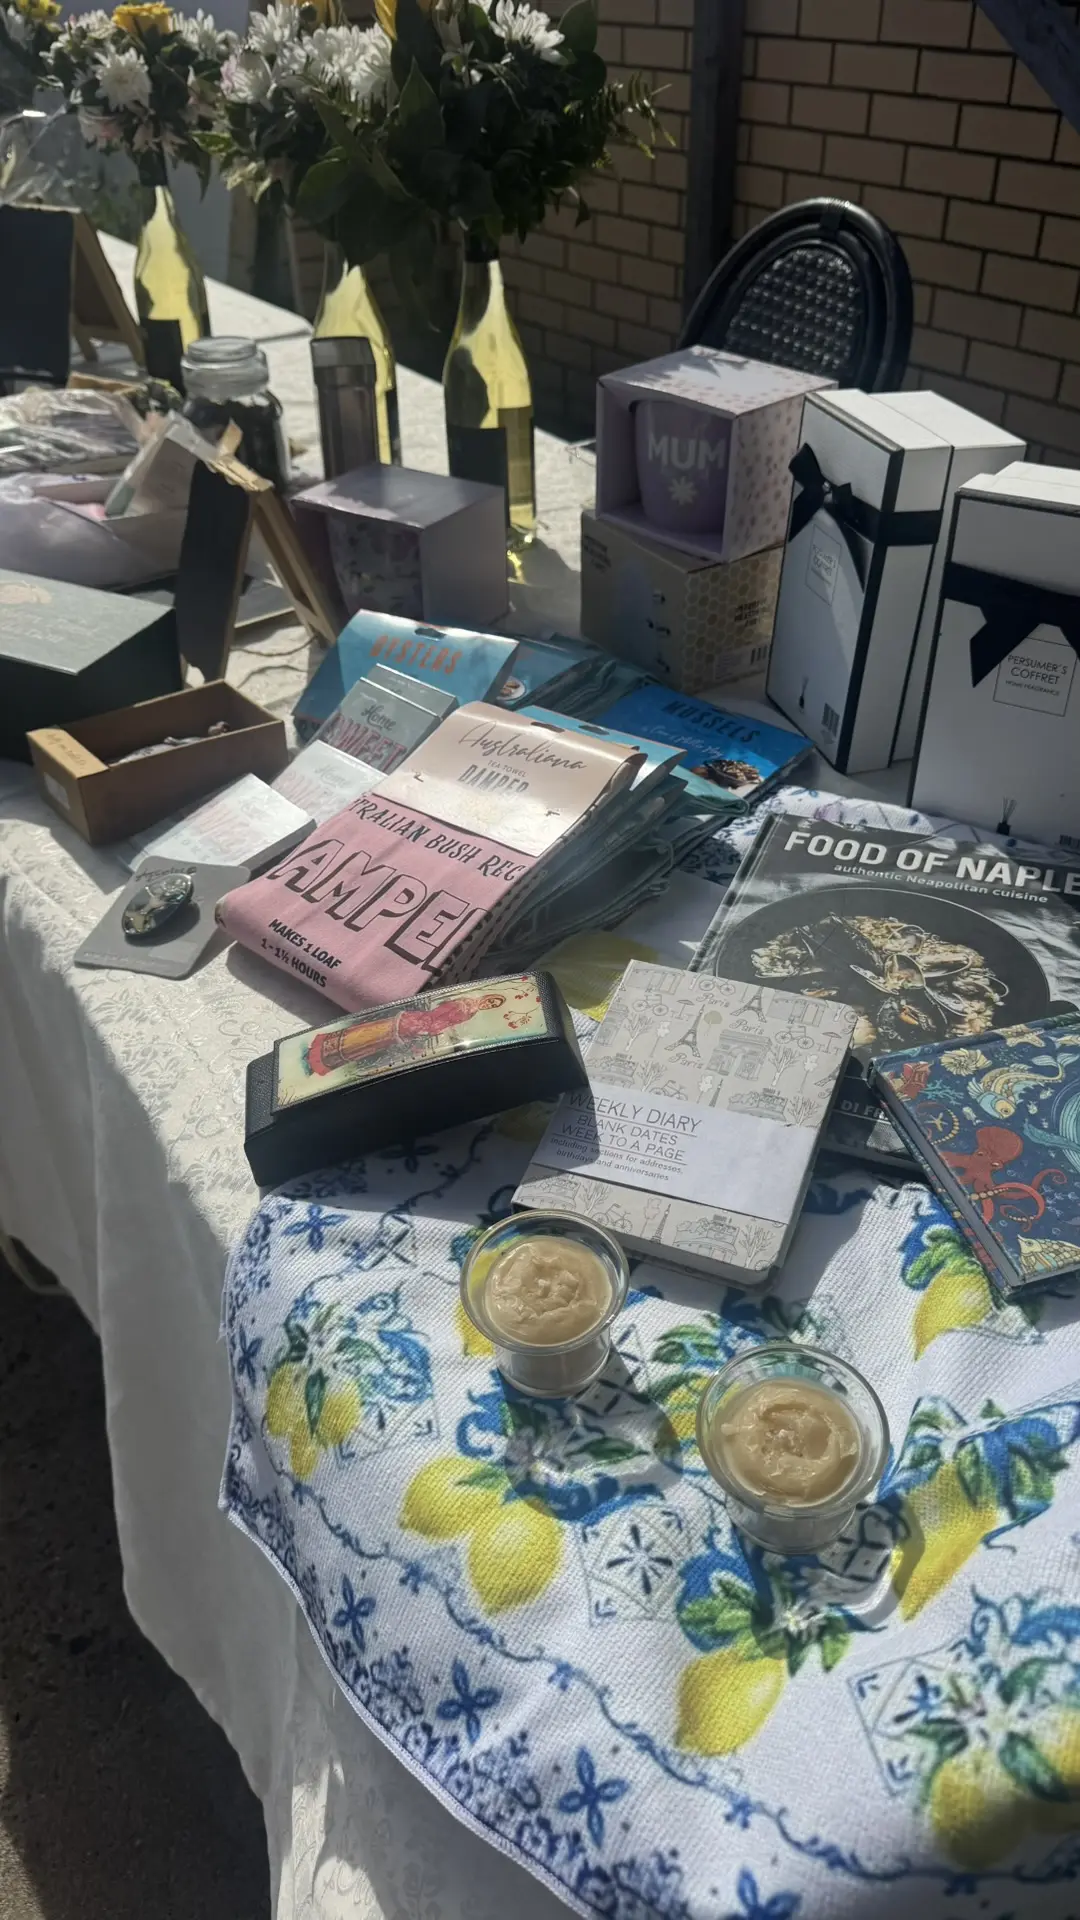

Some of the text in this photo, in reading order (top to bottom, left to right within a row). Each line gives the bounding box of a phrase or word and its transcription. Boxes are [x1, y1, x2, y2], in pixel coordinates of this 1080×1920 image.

[648, 434, 727, 470] MUM
[369, 635, 462, 674] OYSTERS
[1011, 666, 1060, 685] COFFRET
[361, 704, 396, 731] Home
[661, 700, 761, 743] MUSSELS
[458, 720, 587, 770] Australiana
[488, 760, 527, 778] TEA TOWEL
[349, 792, 431, 842] TRALIAN
[424, 833, 483, 866] BUSH
[784, 831, 888, 864] FOOD
[896, 848, 949, 874] OF
[834, 863, 1048, 904] authentic Neapolitan cuisine
[268, 918, 342, 969] MAKES 1 LOAF
[291, 956, 328, 988] HOURS
[696, 992, 730, 1008] Paris
[729, 1018, 765, 1035] Paris
[668, 1052, 705, 1069] Paris
[570, 1093, 702, 1133] WEEKLY DIARY
[841, 1100, 859, 1113] DI
[562, 1122, 686, 1161] WEEK TO A PAGE
[577, 1114, 678, 1146] BLANK DATES
[551, 1136, 588, 1153] including
[591, 1147, 623, 1160] sections
[625, 1153, 638, 1163] for
[597, 1159, 612, 1168] and
[613, 1163, 669, 1181] anniversaries
